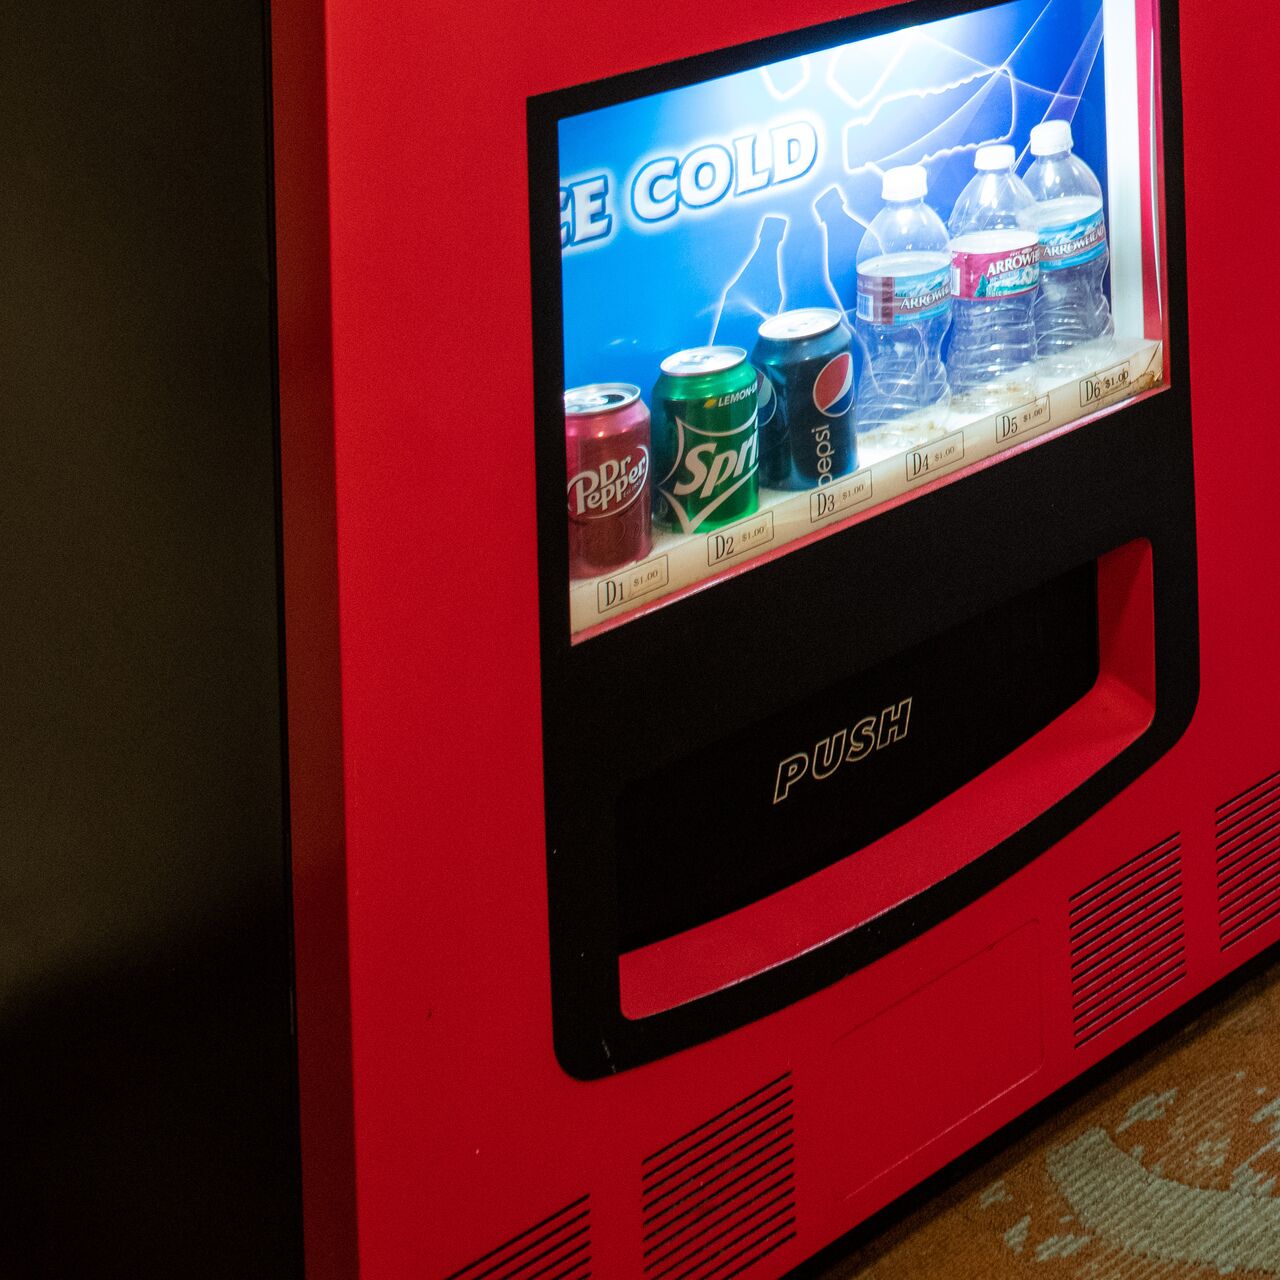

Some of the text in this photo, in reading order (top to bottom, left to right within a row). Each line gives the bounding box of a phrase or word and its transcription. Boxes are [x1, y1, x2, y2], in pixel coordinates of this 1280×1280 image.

[630, 120, 818, 223] COLD
[986, 250, 1039, 278] ARROWH
[1084, 371, 1129, 401] D6 $1.00
[1001, 407, 1043, 438] D5 $1.00
[599, 456, 632, 488] Dr
[673, 418, 759, 499] Spri
[811, 424, 835, 488] pepsi
[912, 447, 955, 476] D4 $1.00
[567, 456, 646, 516] Pepper
[817, 485, 864, 517] D3 $1.00
[715, 526, 765, 560] D2 $1.00
[605, 570, 658, 607] D1 $1.00
[773, 696, 913, 805] PUSH
